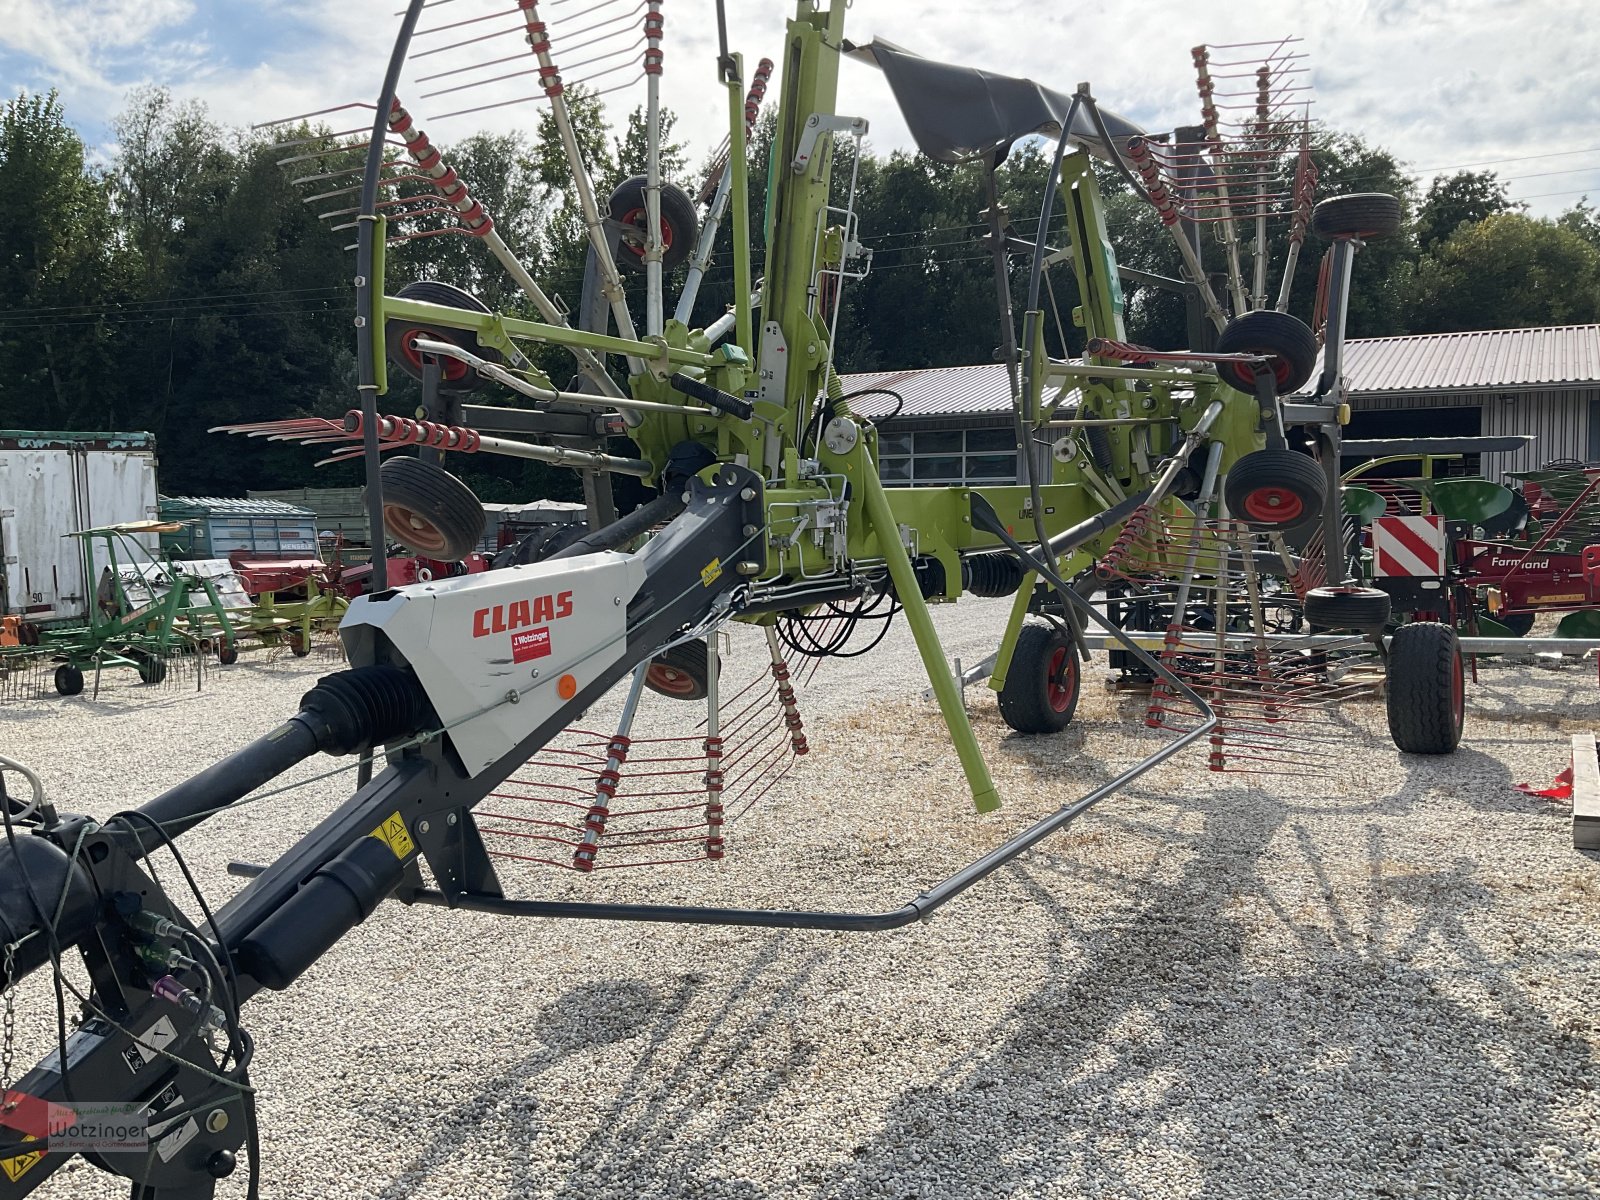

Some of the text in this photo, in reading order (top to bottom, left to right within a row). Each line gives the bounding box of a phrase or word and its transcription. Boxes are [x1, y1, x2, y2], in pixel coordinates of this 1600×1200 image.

[32, 592, 43, 603] 90
[472, 590, 573, 638] CLAAS
[518, 631, 548, 645] Wotzinger
